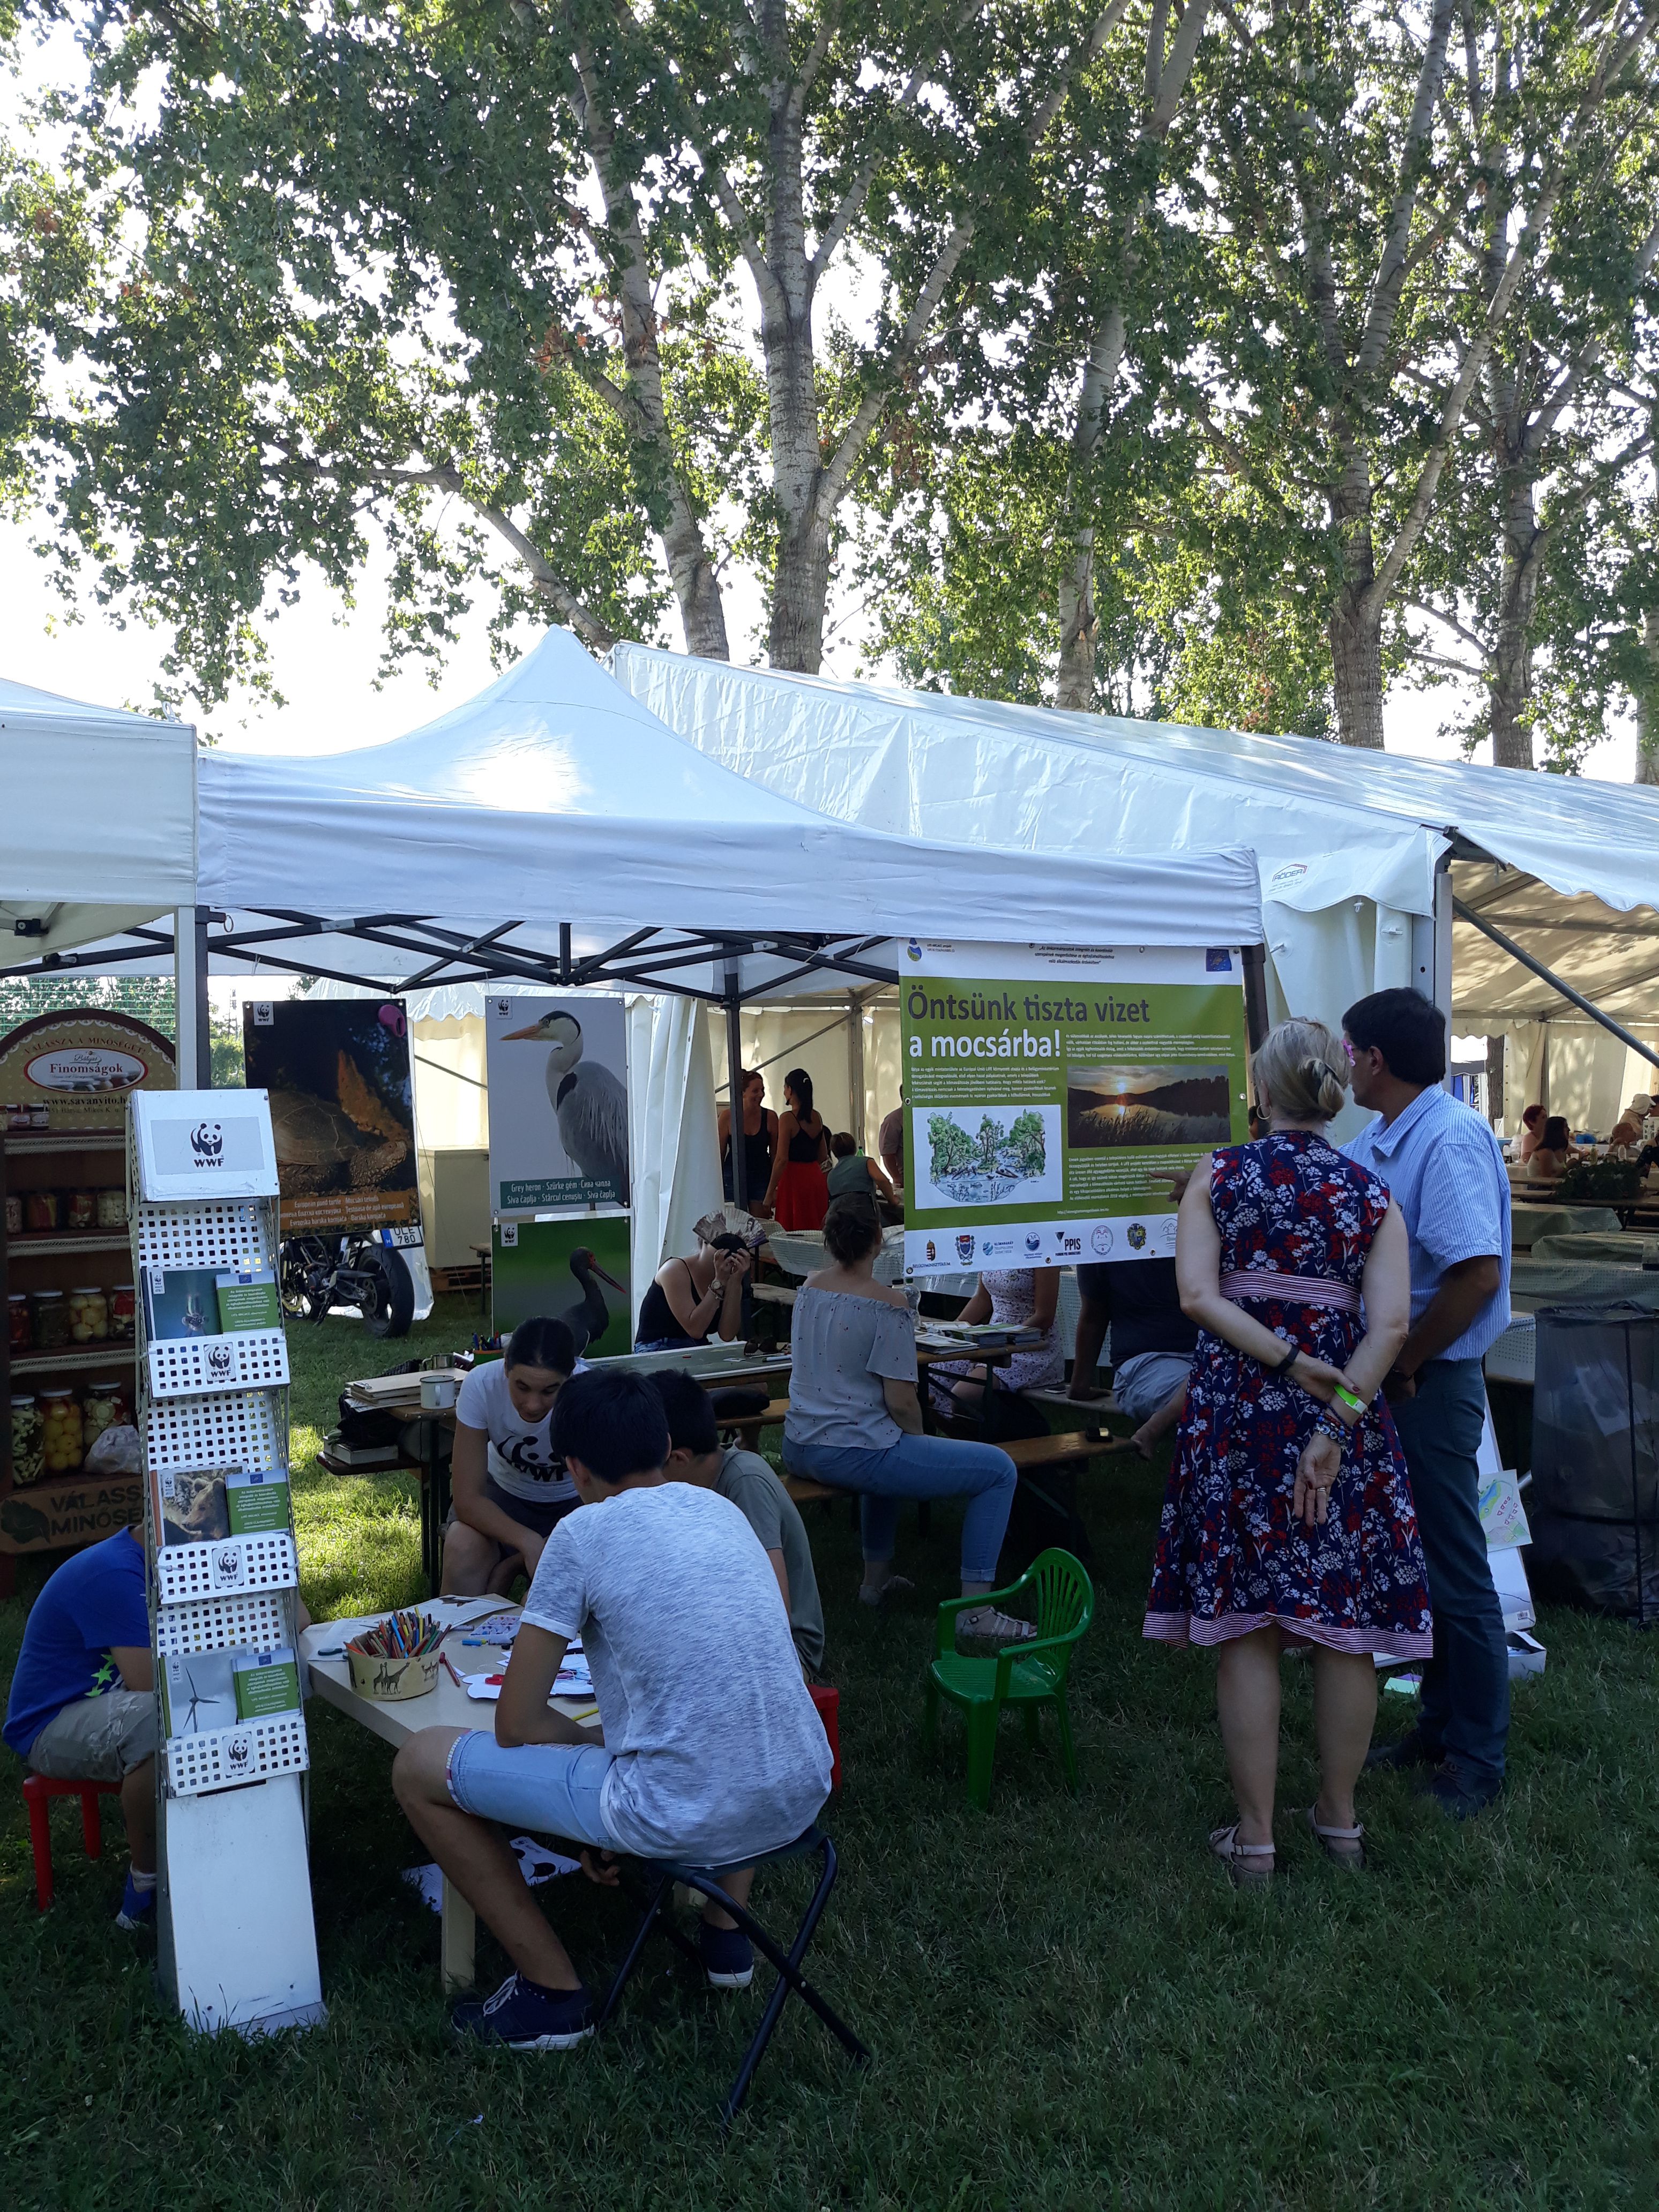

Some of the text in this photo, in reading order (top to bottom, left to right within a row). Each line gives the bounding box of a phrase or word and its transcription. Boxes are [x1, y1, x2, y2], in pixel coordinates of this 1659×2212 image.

[908, 984, 1150, 1023] Öntsünk tiszta vizet
[909, 1028, 1060, 1058] a mocsárba!
[50, 1063, 123, 1076] Finomságok
[43, 1096, 126, 1106] www.savanyito.h
[194, 1157, 225, 1168] WWF
[511, 1183, 525, 1193] Grey
[525, 1183, 541, 1192] heron
[545, 1180, 564, 1191] Szürke
[565, 1180, 577, 1191] gém
[507, 1195, 519, 1204] Siva
[520, 1194, 537, 1205] čaplja
[542, 1193, 561, 1202] Stârcul
[587, 1191, 599, 1200] Siva
[599, 1189, 616, 1200] čaplja
[398, 1234, 416, 1244] 780
[1064, 1238, 1081, 1251] PPIS
[211, 1370, 231, 1378] WWF
[50, 1484, 142, 1512] VÁLASS
[51, 1503, 143, 1536] MINŐSÉ
[230, 1761, 249, 1770] WWF
